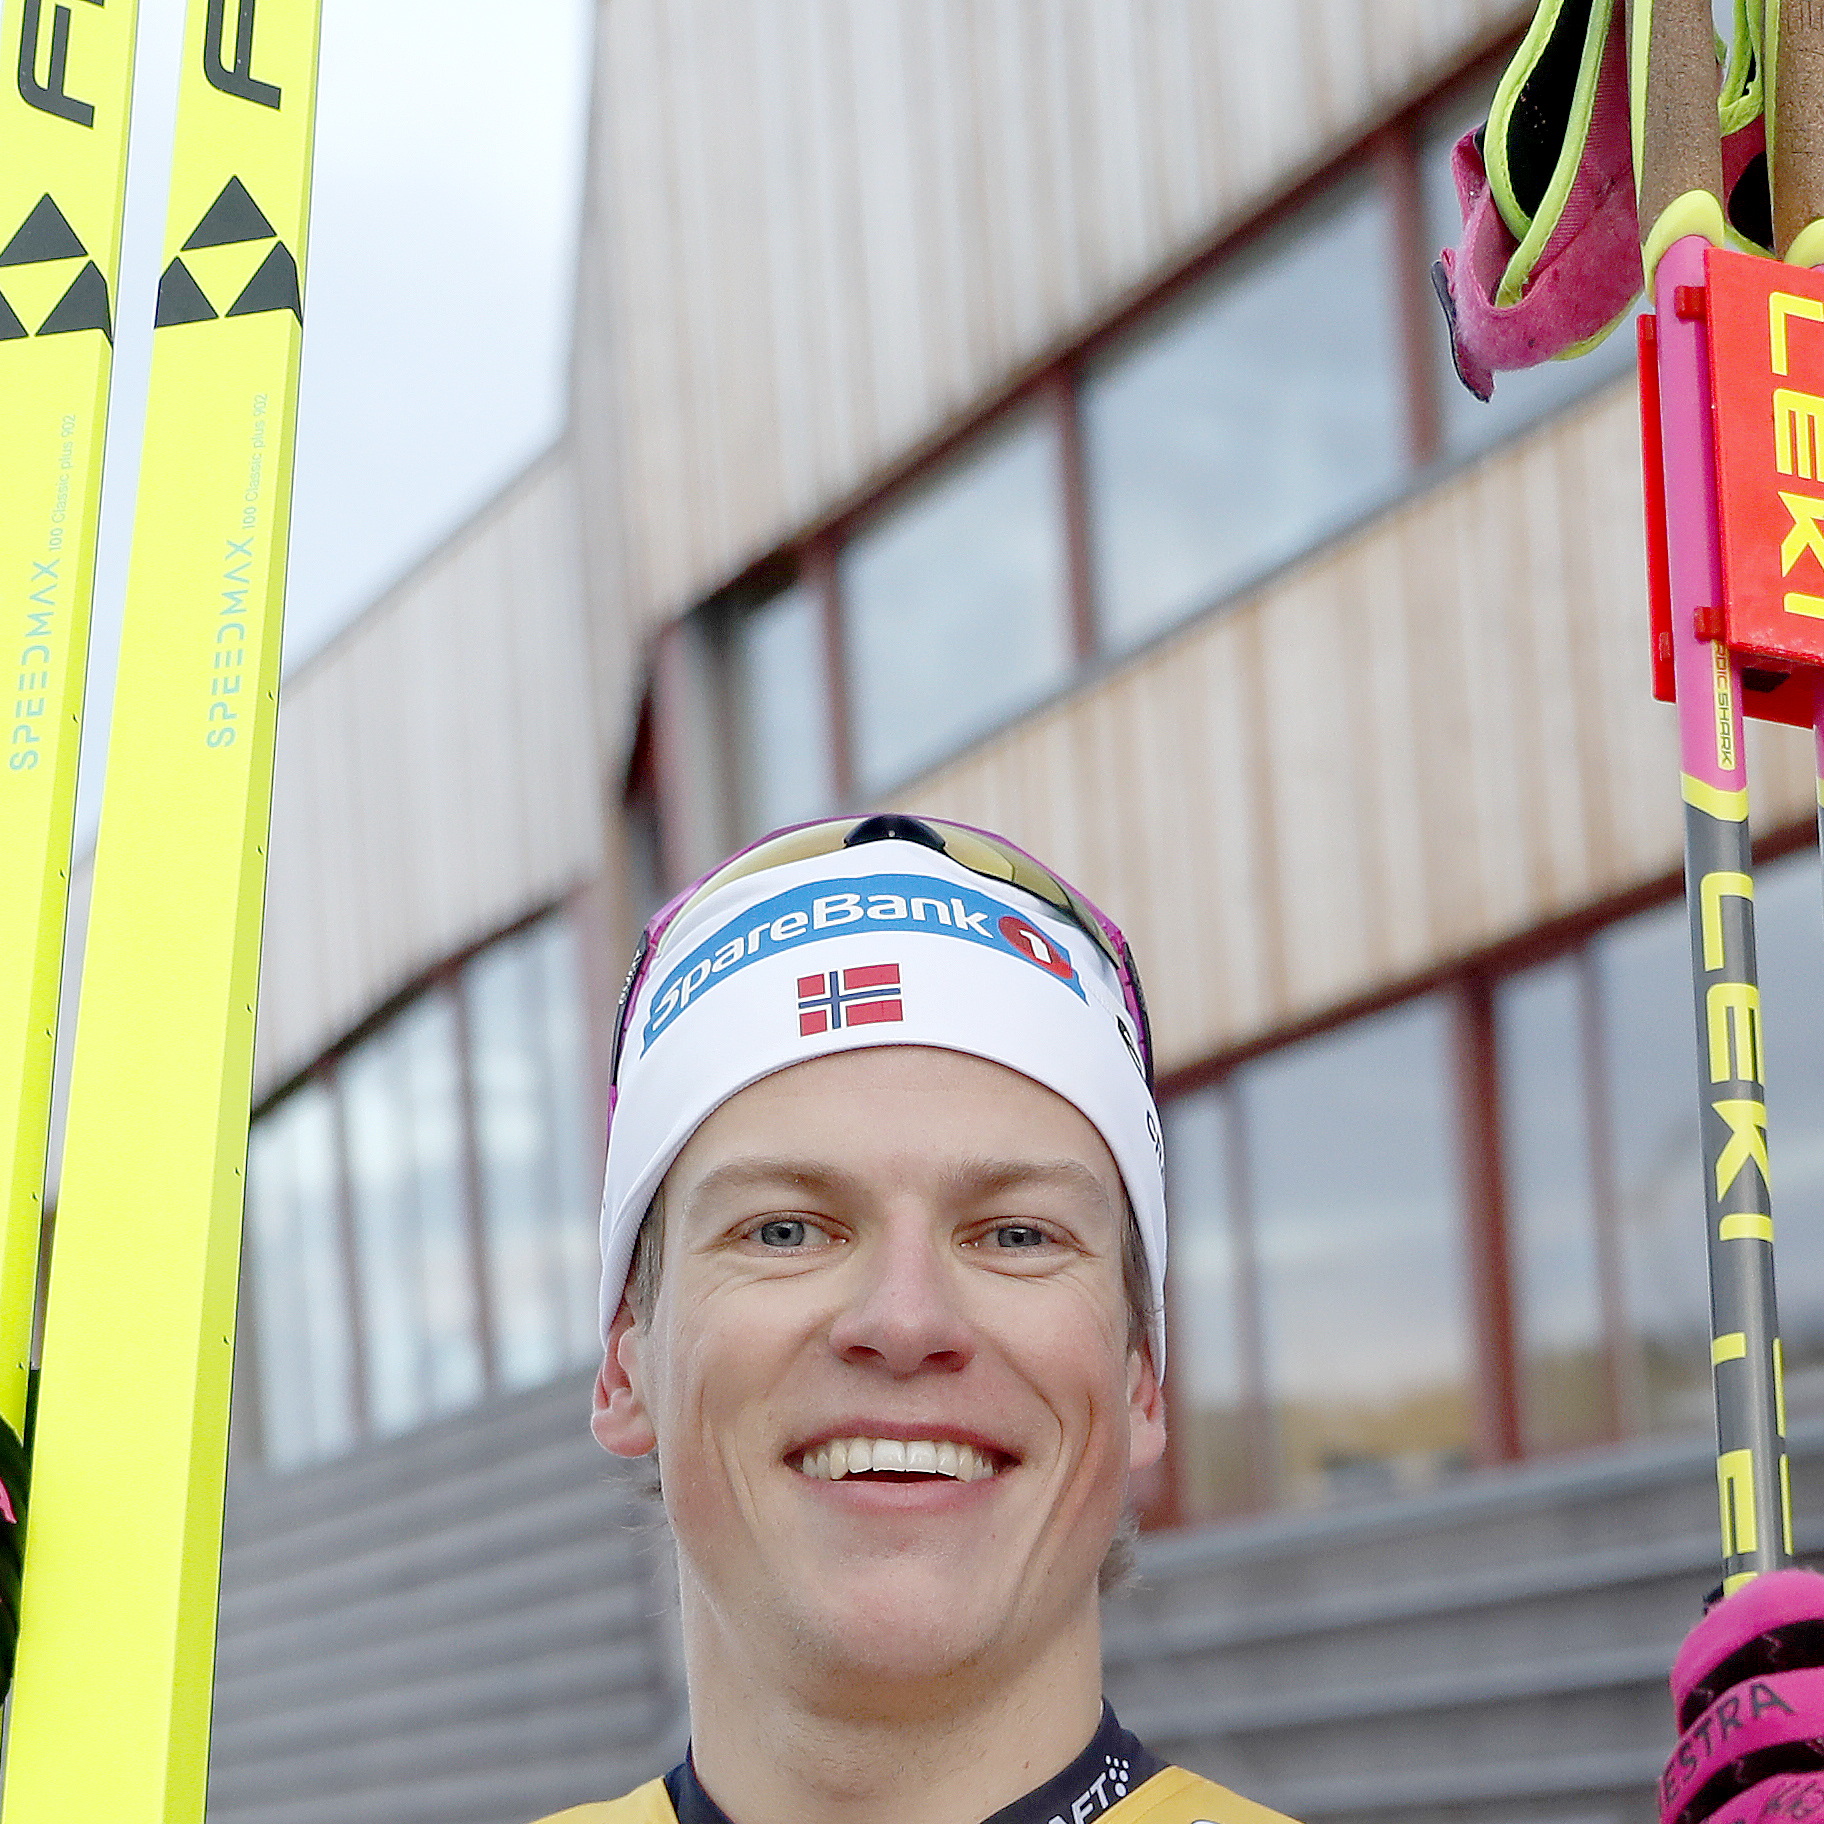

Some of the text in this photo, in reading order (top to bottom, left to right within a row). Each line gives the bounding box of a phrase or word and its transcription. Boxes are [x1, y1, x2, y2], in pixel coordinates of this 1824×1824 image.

[9, 559, 60, 770] SPEEDMAX
[52, 474, 69, 523] Classic
[206, 537, 254, 747] SPEEDMAX
[245, 453, 262, 501] Classic
[1718, 693, 1732, 765] SHARK
[646, 893, 994, 1032] SpareBank
[1019, 930, 1051, 964] 1
[1699, 871, 1773, 1241] LEKI
[1661, 1683, 1796, 1803] ESTRA
